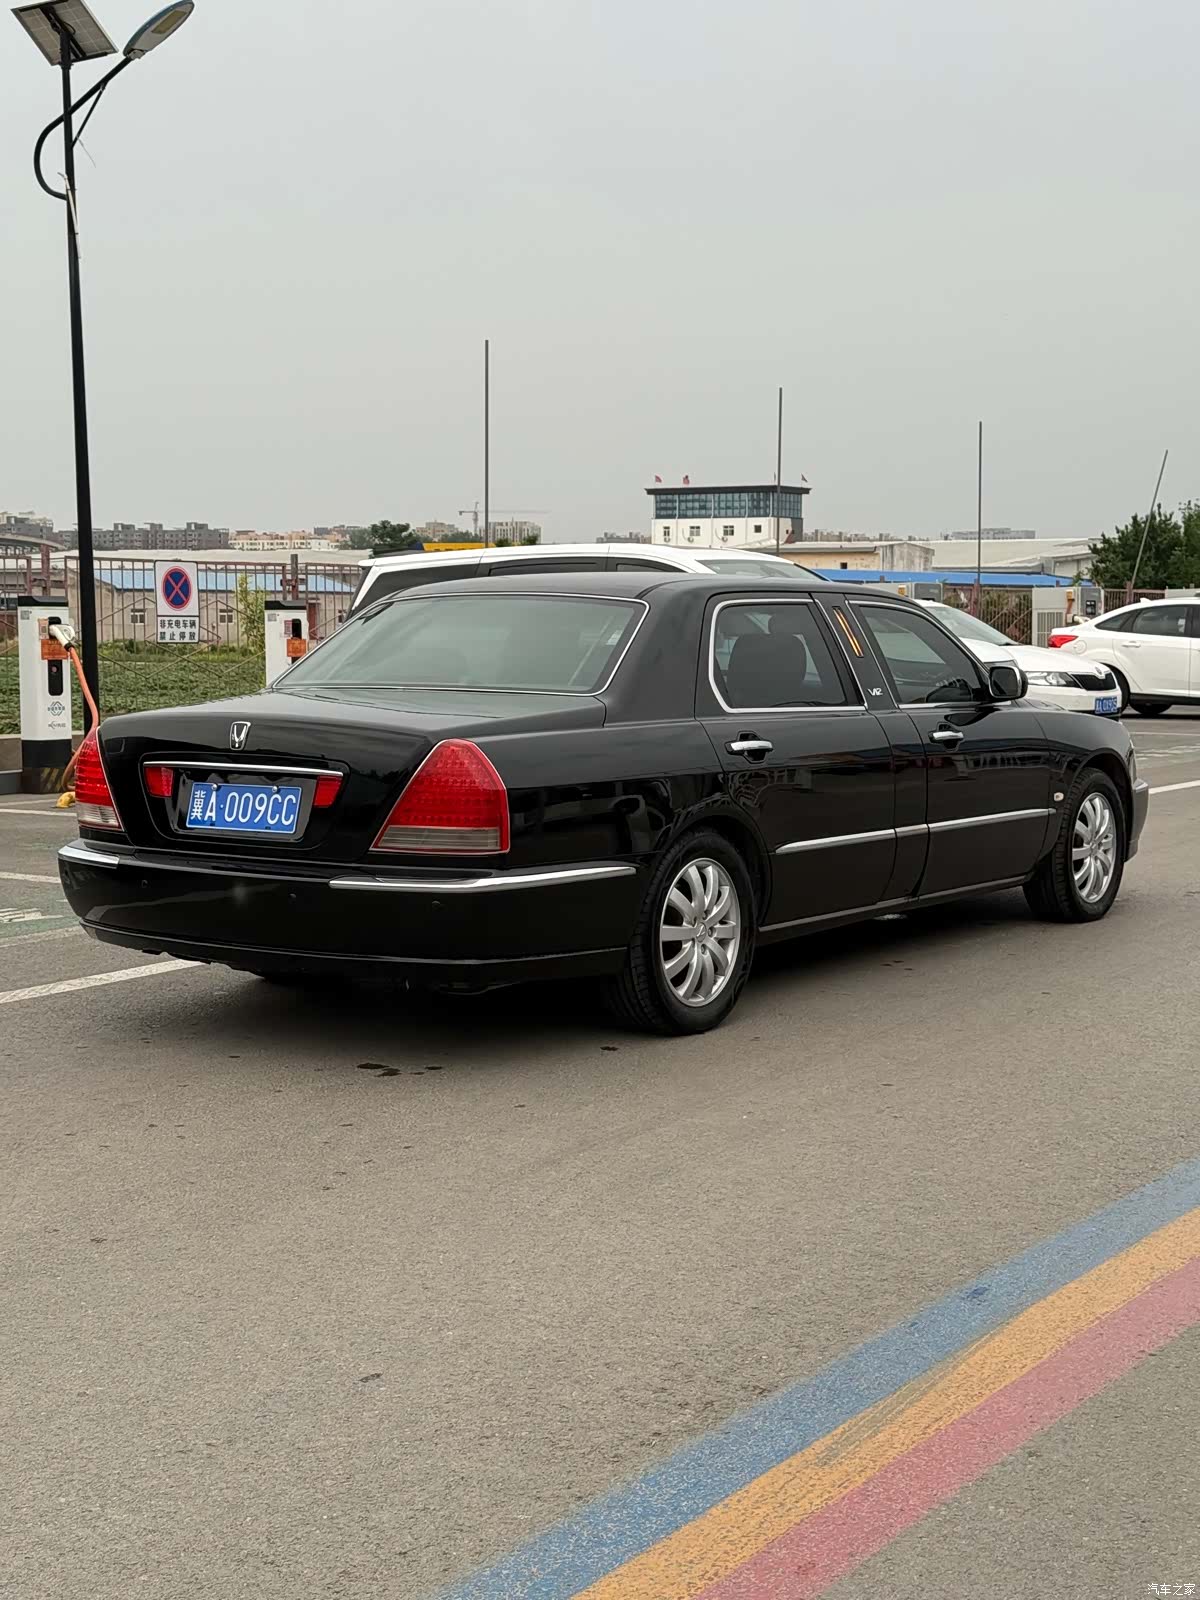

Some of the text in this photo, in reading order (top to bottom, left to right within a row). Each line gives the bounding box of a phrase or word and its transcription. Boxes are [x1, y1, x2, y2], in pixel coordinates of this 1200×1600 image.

[160, 619, 197, 629] 非充电车辆
[159, 631, 196, 641] 禁止停放
